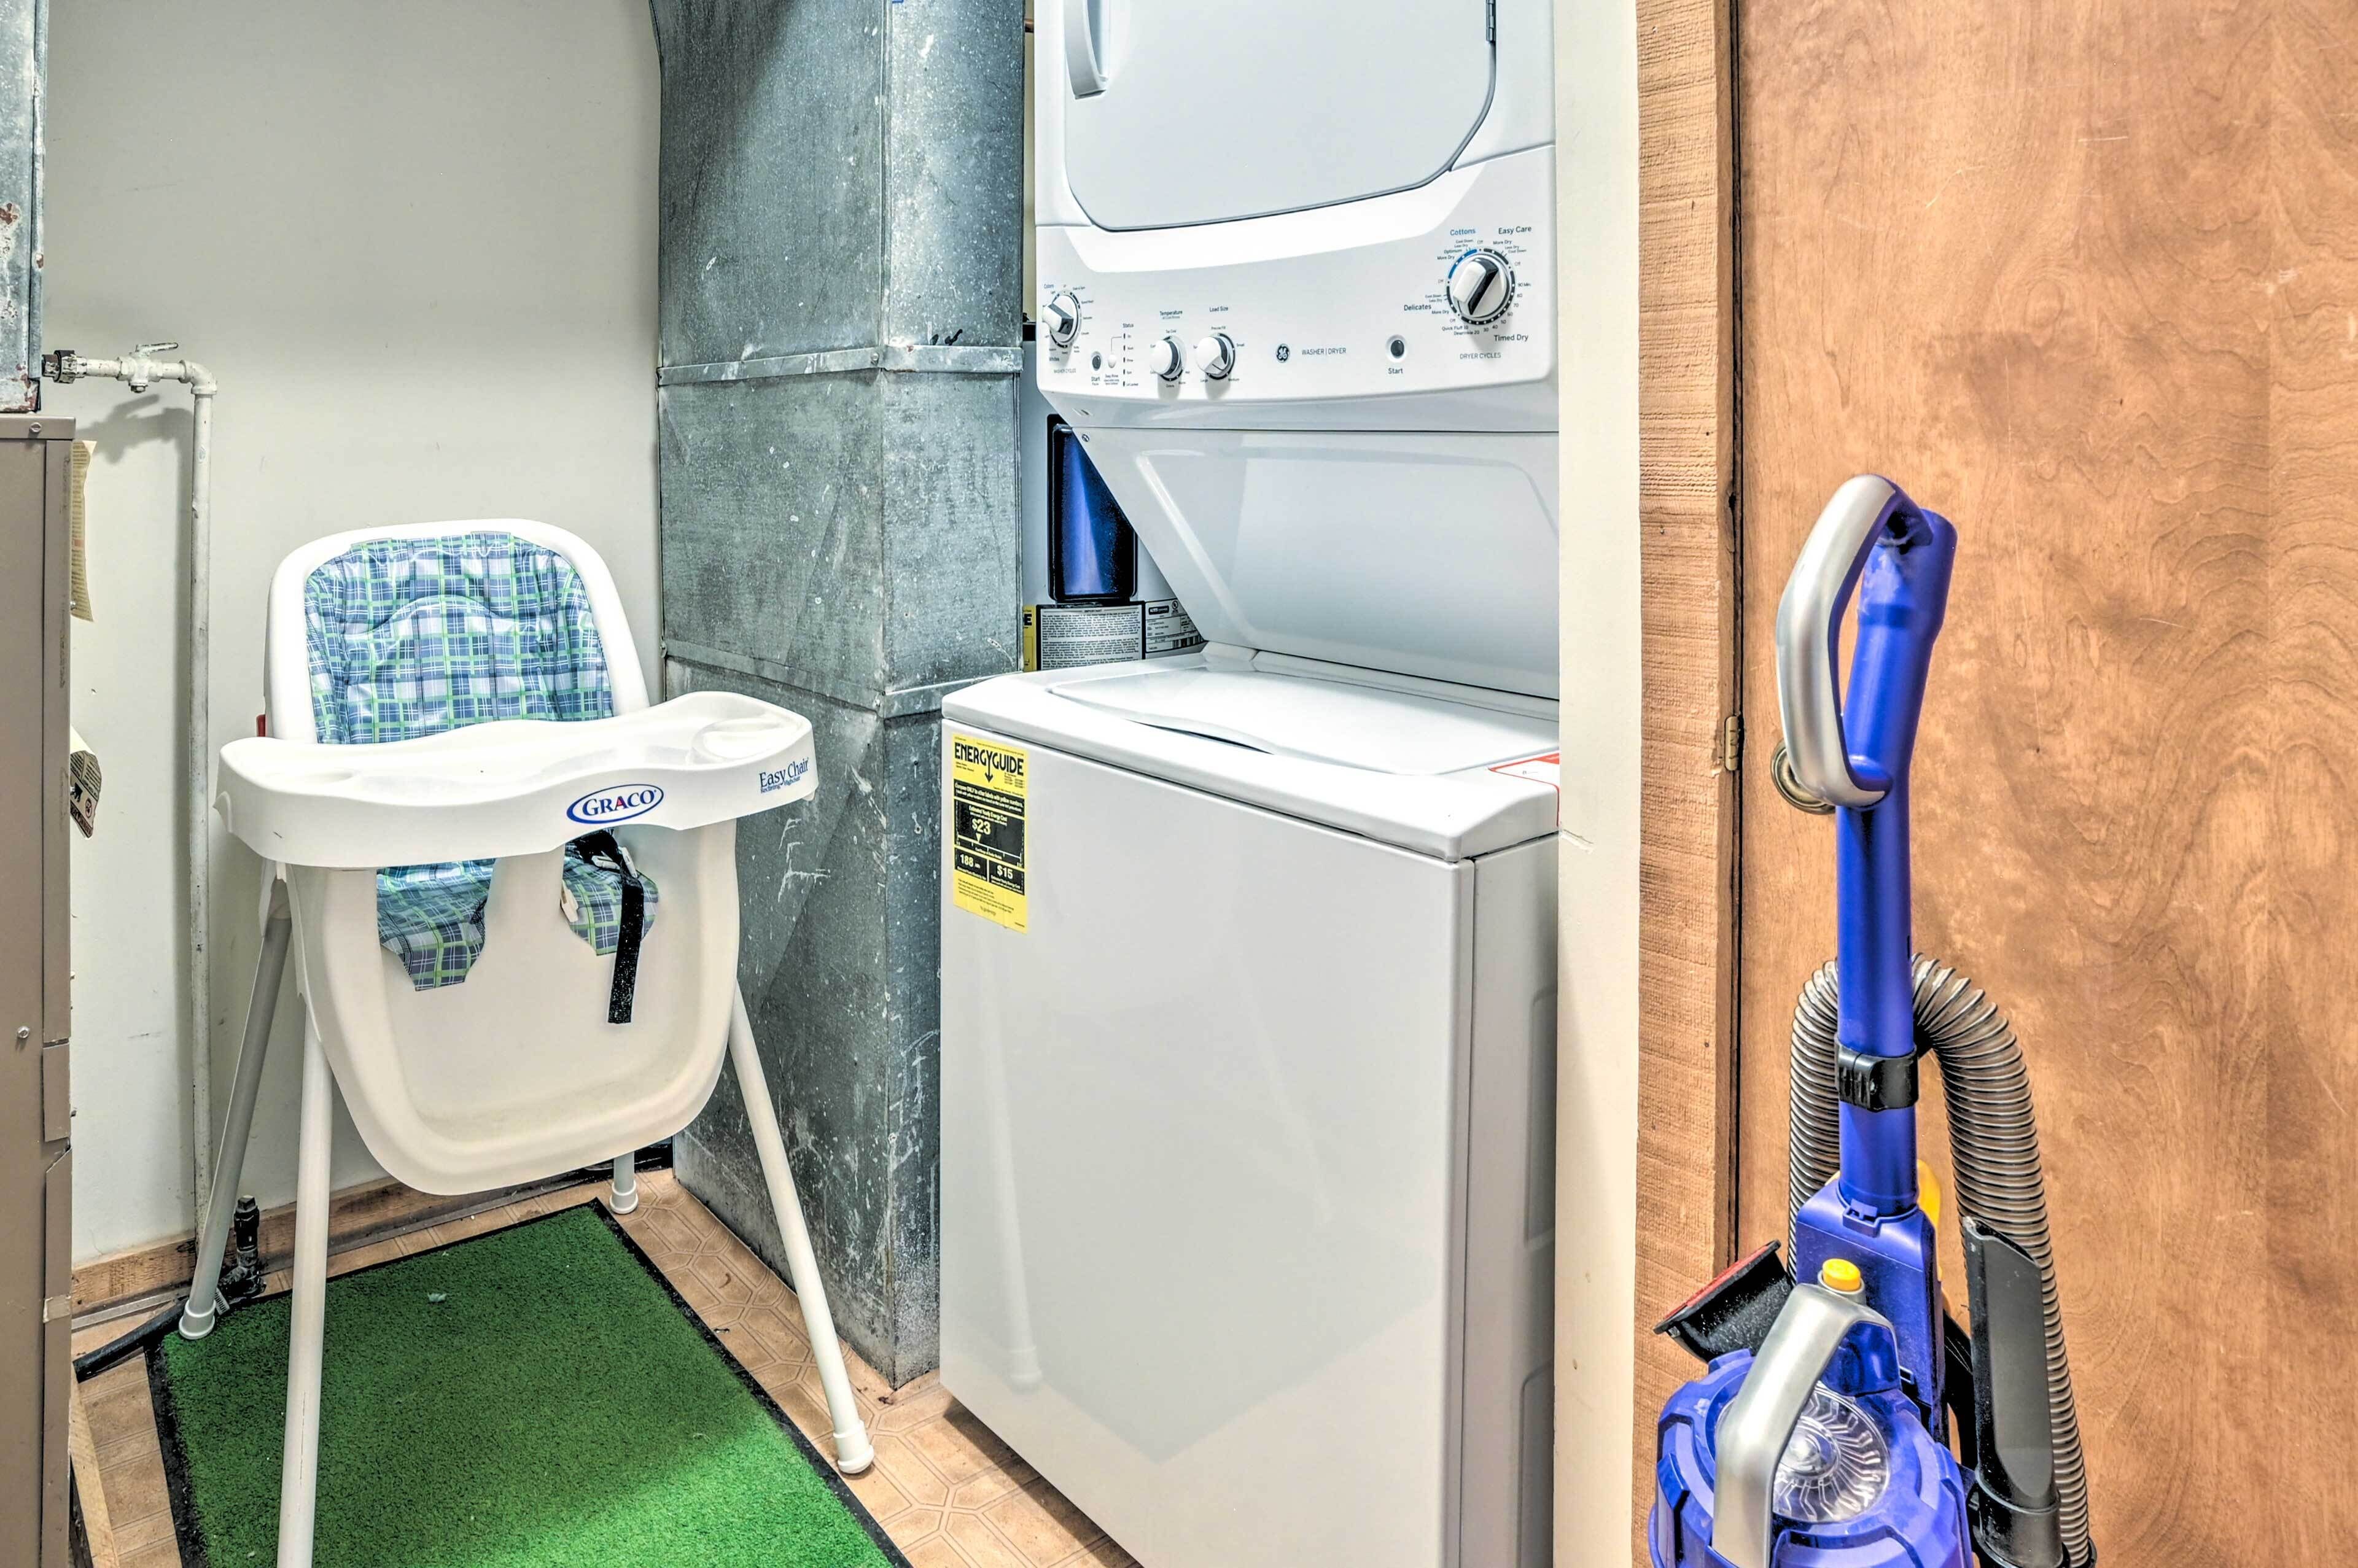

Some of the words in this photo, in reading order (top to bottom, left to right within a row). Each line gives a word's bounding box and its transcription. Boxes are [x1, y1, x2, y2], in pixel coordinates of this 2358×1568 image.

[954, 742, 1024, 777] ENERGYGUIDE
[759, 769, 786, 787] Easy
[787, 758, 809, 778] Chair
[582, 790, 656, 816] GRACO
[972, 817, 991, 835] $23
[960, 853, 974, 867] 188
[997, 864, 1014, 880] $15
